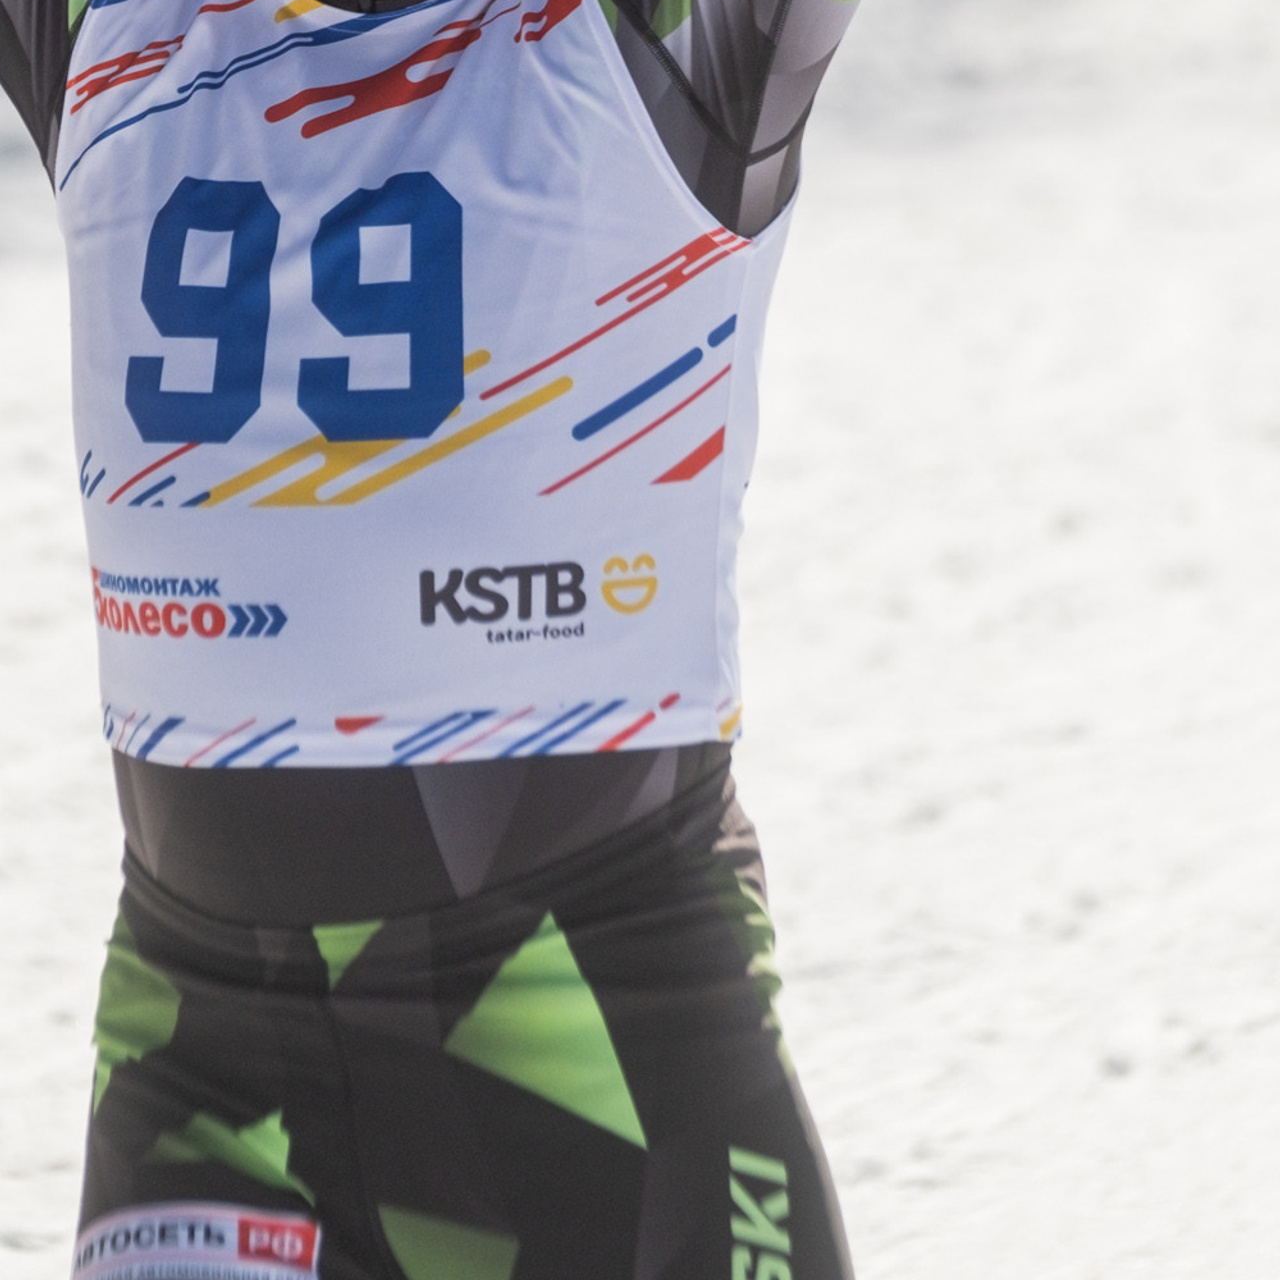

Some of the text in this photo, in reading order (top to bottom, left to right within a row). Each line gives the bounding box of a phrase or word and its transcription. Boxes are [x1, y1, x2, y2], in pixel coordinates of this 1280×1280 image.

[124, 171, 465, 443] 99
[419, 561, 587, 626] KSTB
[486, 622, 585, 643] tatar-food
[249, 1227, 304, 1261] РФ
